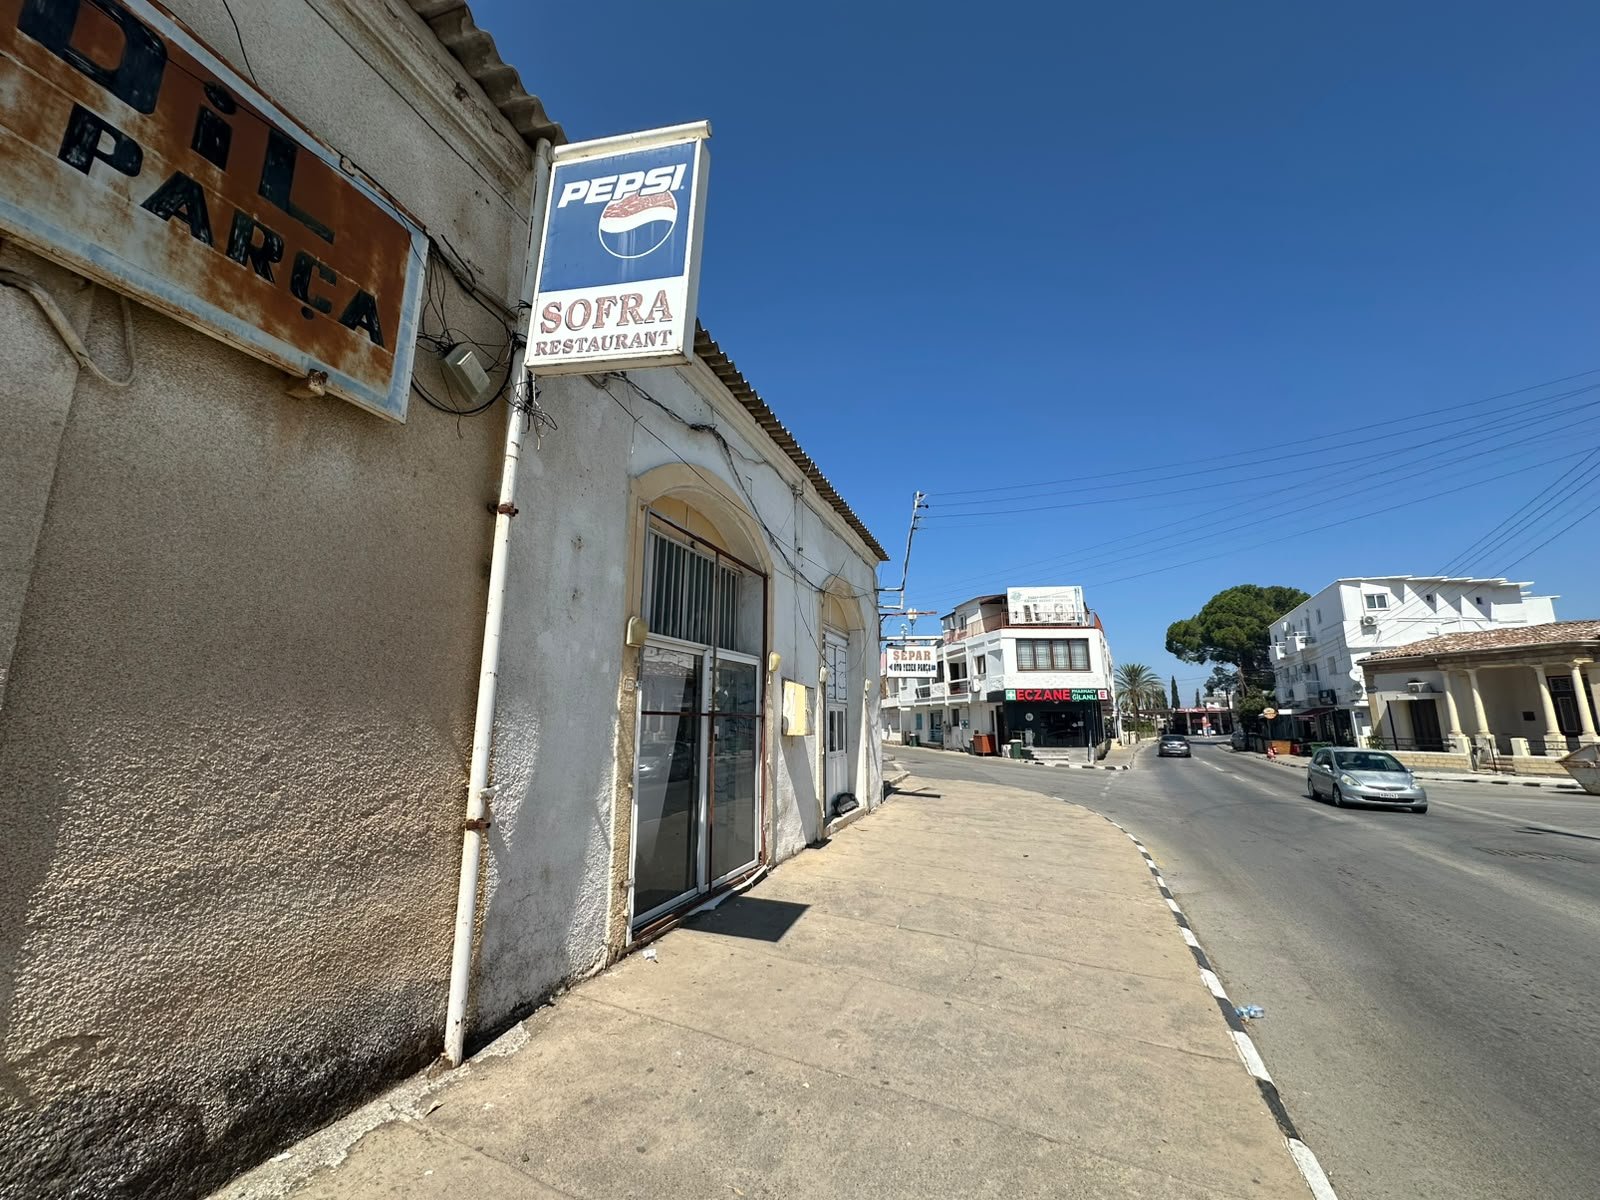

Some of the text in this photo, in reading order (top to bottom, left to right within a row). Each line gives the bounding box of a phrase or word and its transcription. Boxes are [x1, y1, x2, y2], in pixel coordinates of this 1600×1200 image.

[557, 163, 687, 208] PEPSI
[58, 103, 385, 348] PARÇA
[540, 290, 673, 335] SOFRA
[534, 329, 673, 356] RESTAURANT
[893, 650, 931, 660] SEPAR
[1016, 689, 1070, 700] ECZANE
